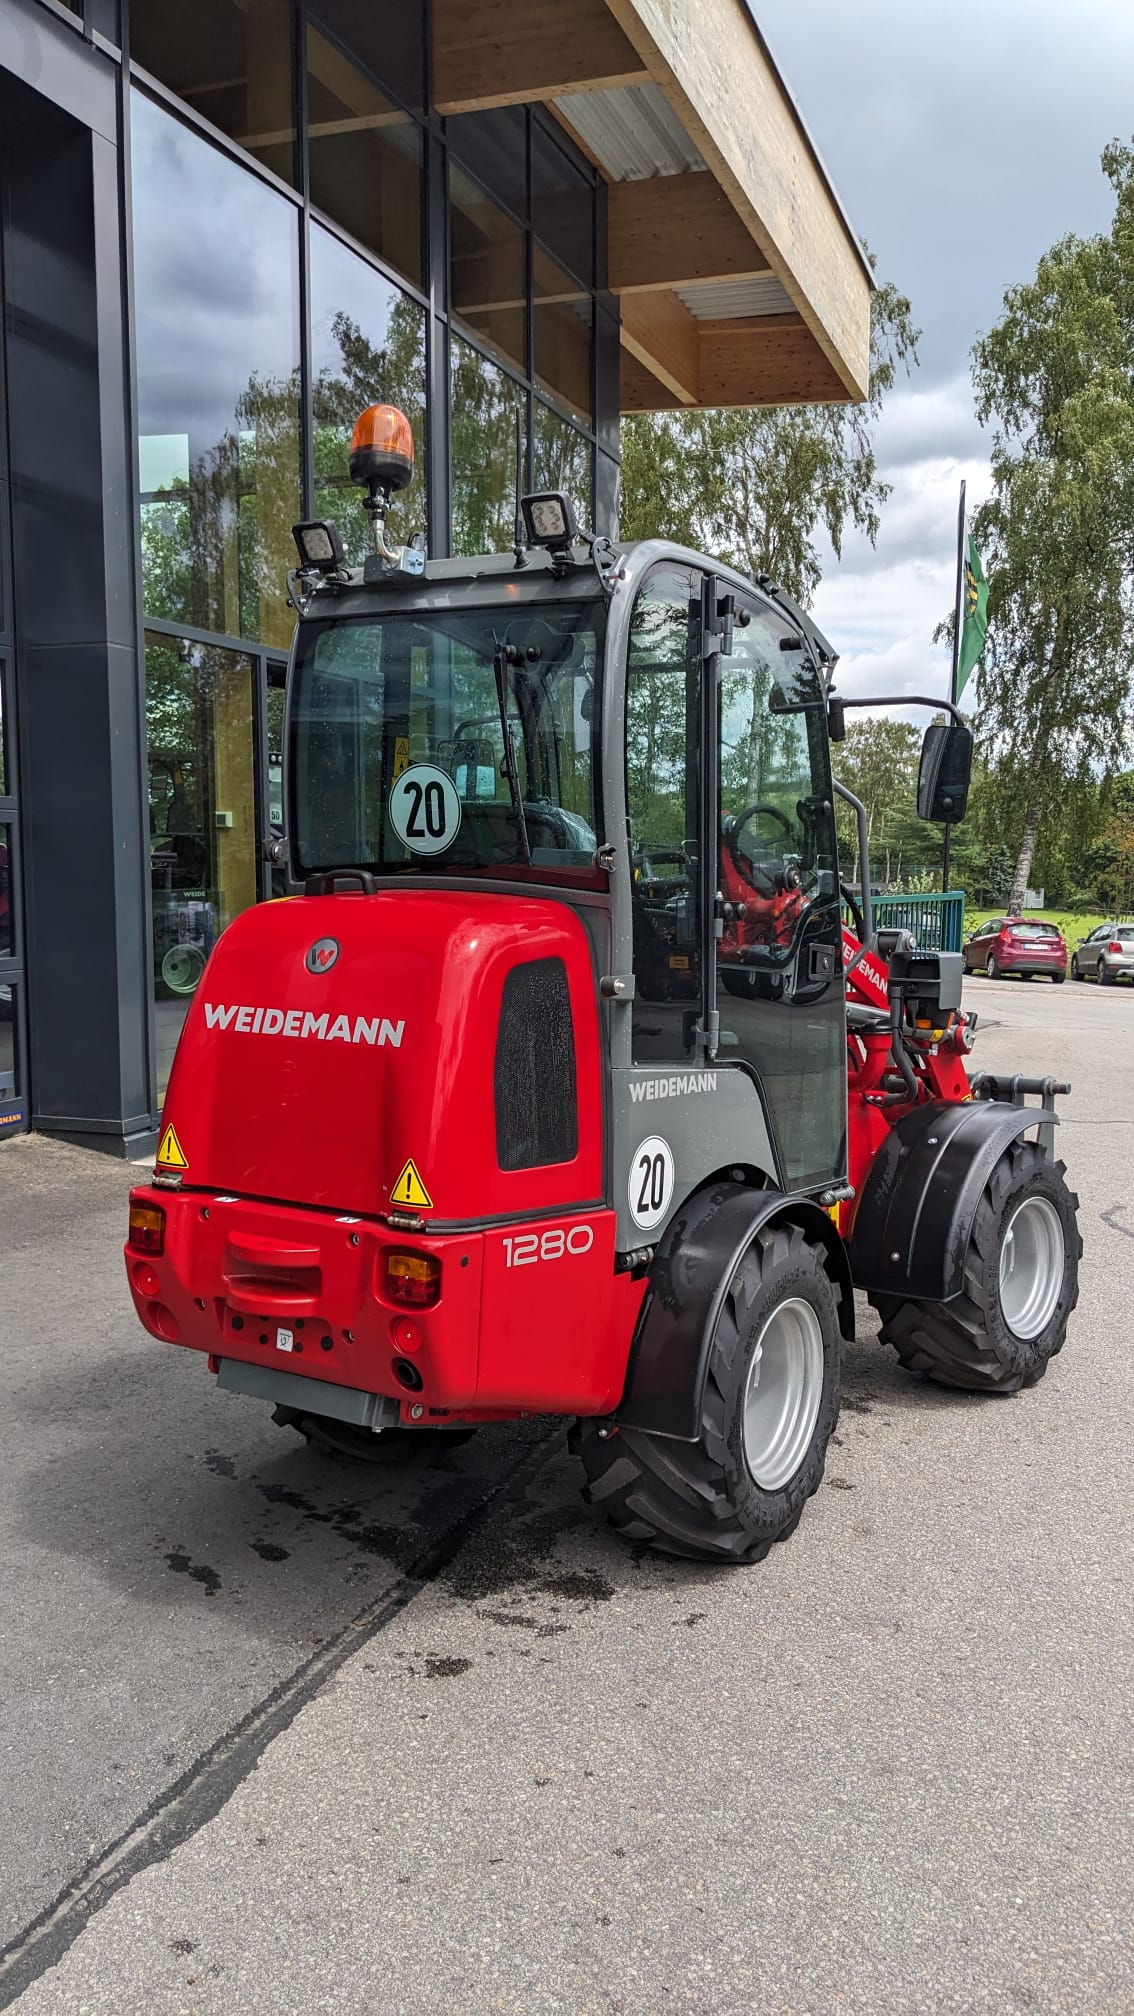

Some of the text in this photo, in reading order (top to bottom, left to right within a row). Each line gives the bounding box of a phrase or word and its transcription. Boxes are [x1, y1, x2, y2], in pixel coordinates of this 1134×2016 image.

[271, 810, 280, 820] 50
[404, 781, 445, 838] 20
[204, 1002, 405, 1048] WEIDEMANN
[628, 1073, 717, 1102] WEIDEMANN
[637, 1153, 665, 1213] 20
[502, 1224, 594, 1268] 1280
